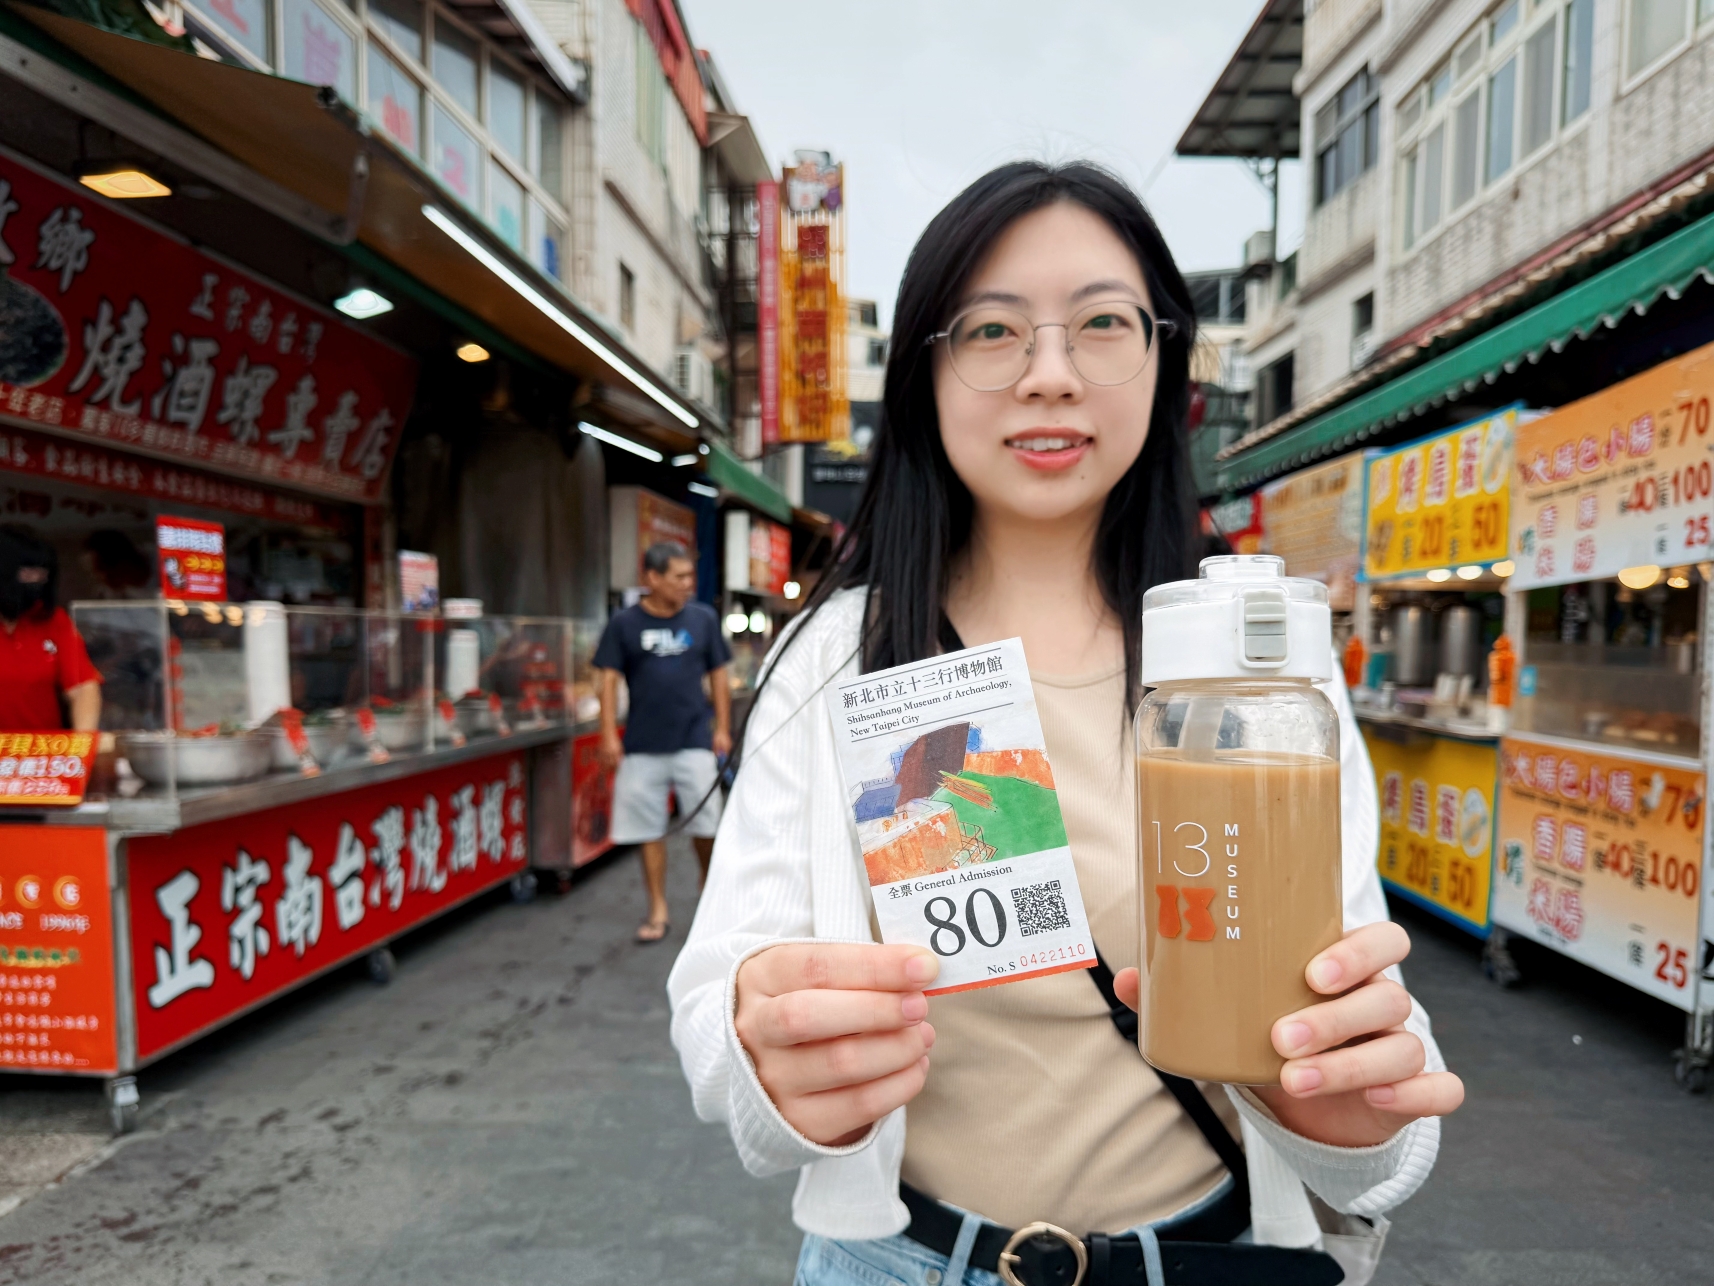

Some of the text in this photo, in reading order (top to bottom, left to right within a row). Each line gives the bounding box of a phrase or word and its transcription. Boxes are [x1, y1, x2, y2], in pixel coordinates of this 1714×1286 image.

[69, 298, 396, 481] 燒酒螺專賣店
[1677, 397, 1711, 447] 70
[1518, 412, 1656, 486] 大腸包小腸
[1628, 476, 1658, 512] 40
[1672, 461, 1711, 508] 100
[1470, 502, 1501, 550] 50
[1683, 514, 1711, 549] 25
[843, 655, 1004, 709] 新北市立十三行博物館
[847, 678, 1013, 727] Shihsanhang Museum of Archaeology,
[850, 713, 920, 738] New Taipei City
[1504, 755, 1635, 812] 大腸包小腸
[1152, 820, 1211, 877] 13
[1606, 841, 1635, 880] 40
[147, 782, 508, 1009] 正宗南台灣燒酒螺
[887, 863, 1013, 901] 全票 General Admission
[1224, 823, 1241, 940] MUSEUM
[1649, 852, 1698, 898] 100
[923, 887, 1008, 957] 80
[987, 942, 1087, 976] No. S 0422110
[1655, 941, 1688, 989] 25
